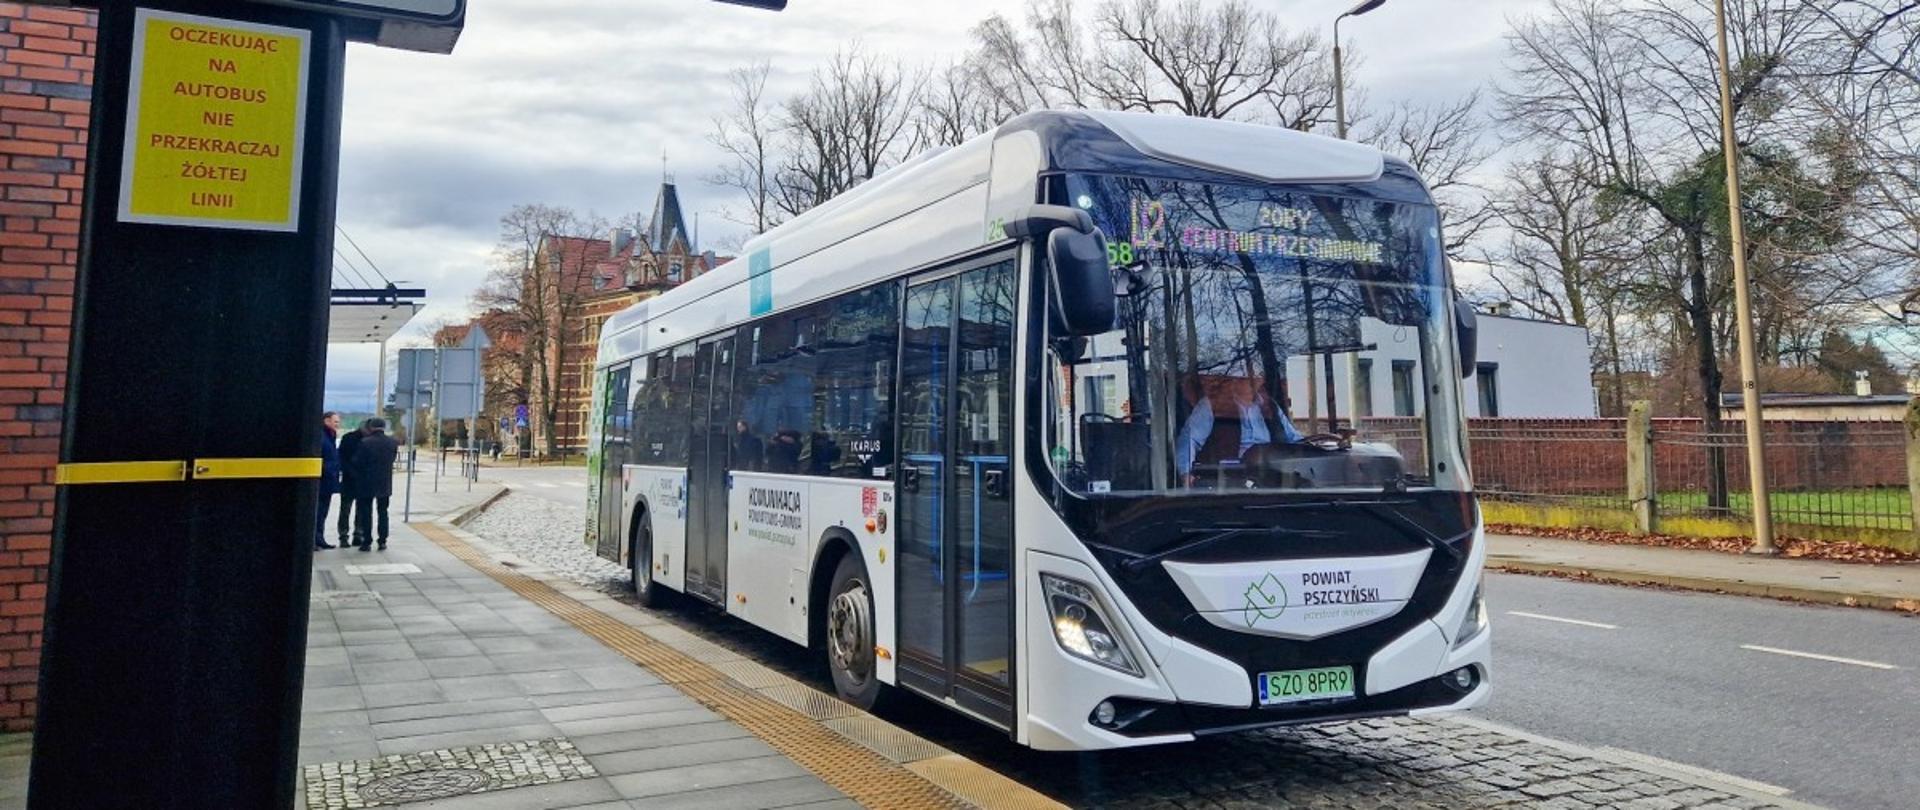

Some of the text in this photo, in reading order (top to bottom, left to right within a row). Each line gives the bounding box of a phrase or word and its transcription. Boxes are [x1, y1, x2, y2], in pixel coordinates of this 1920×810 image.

[169, 26, 279, 54] OCZEKUJĄC
[208, 58, 237, 74] NA
[173, 81, 267, 104] AUTOBUS
[202, 111, 235, 127] NIE
[150, 133, 281, 158] PRZEKRACZAJ
[180, 160, 248, 182] ŻÓŁTEJ
[190, 191, 234, 209] LINII
[1183, 227, 1264, 254] CENTRUM
[850, 440, 881, 452] IKARUS
[748, 487, 801, 513] KOMUNIKACJA
[1302, 570, 1351, 586] POWIAT
[1303, 585, 1380, 606] PSZCZYŃSKI
[1270, 674, 1303, 697] SZO
[1308, 671, 1348, 693] 8PR9
